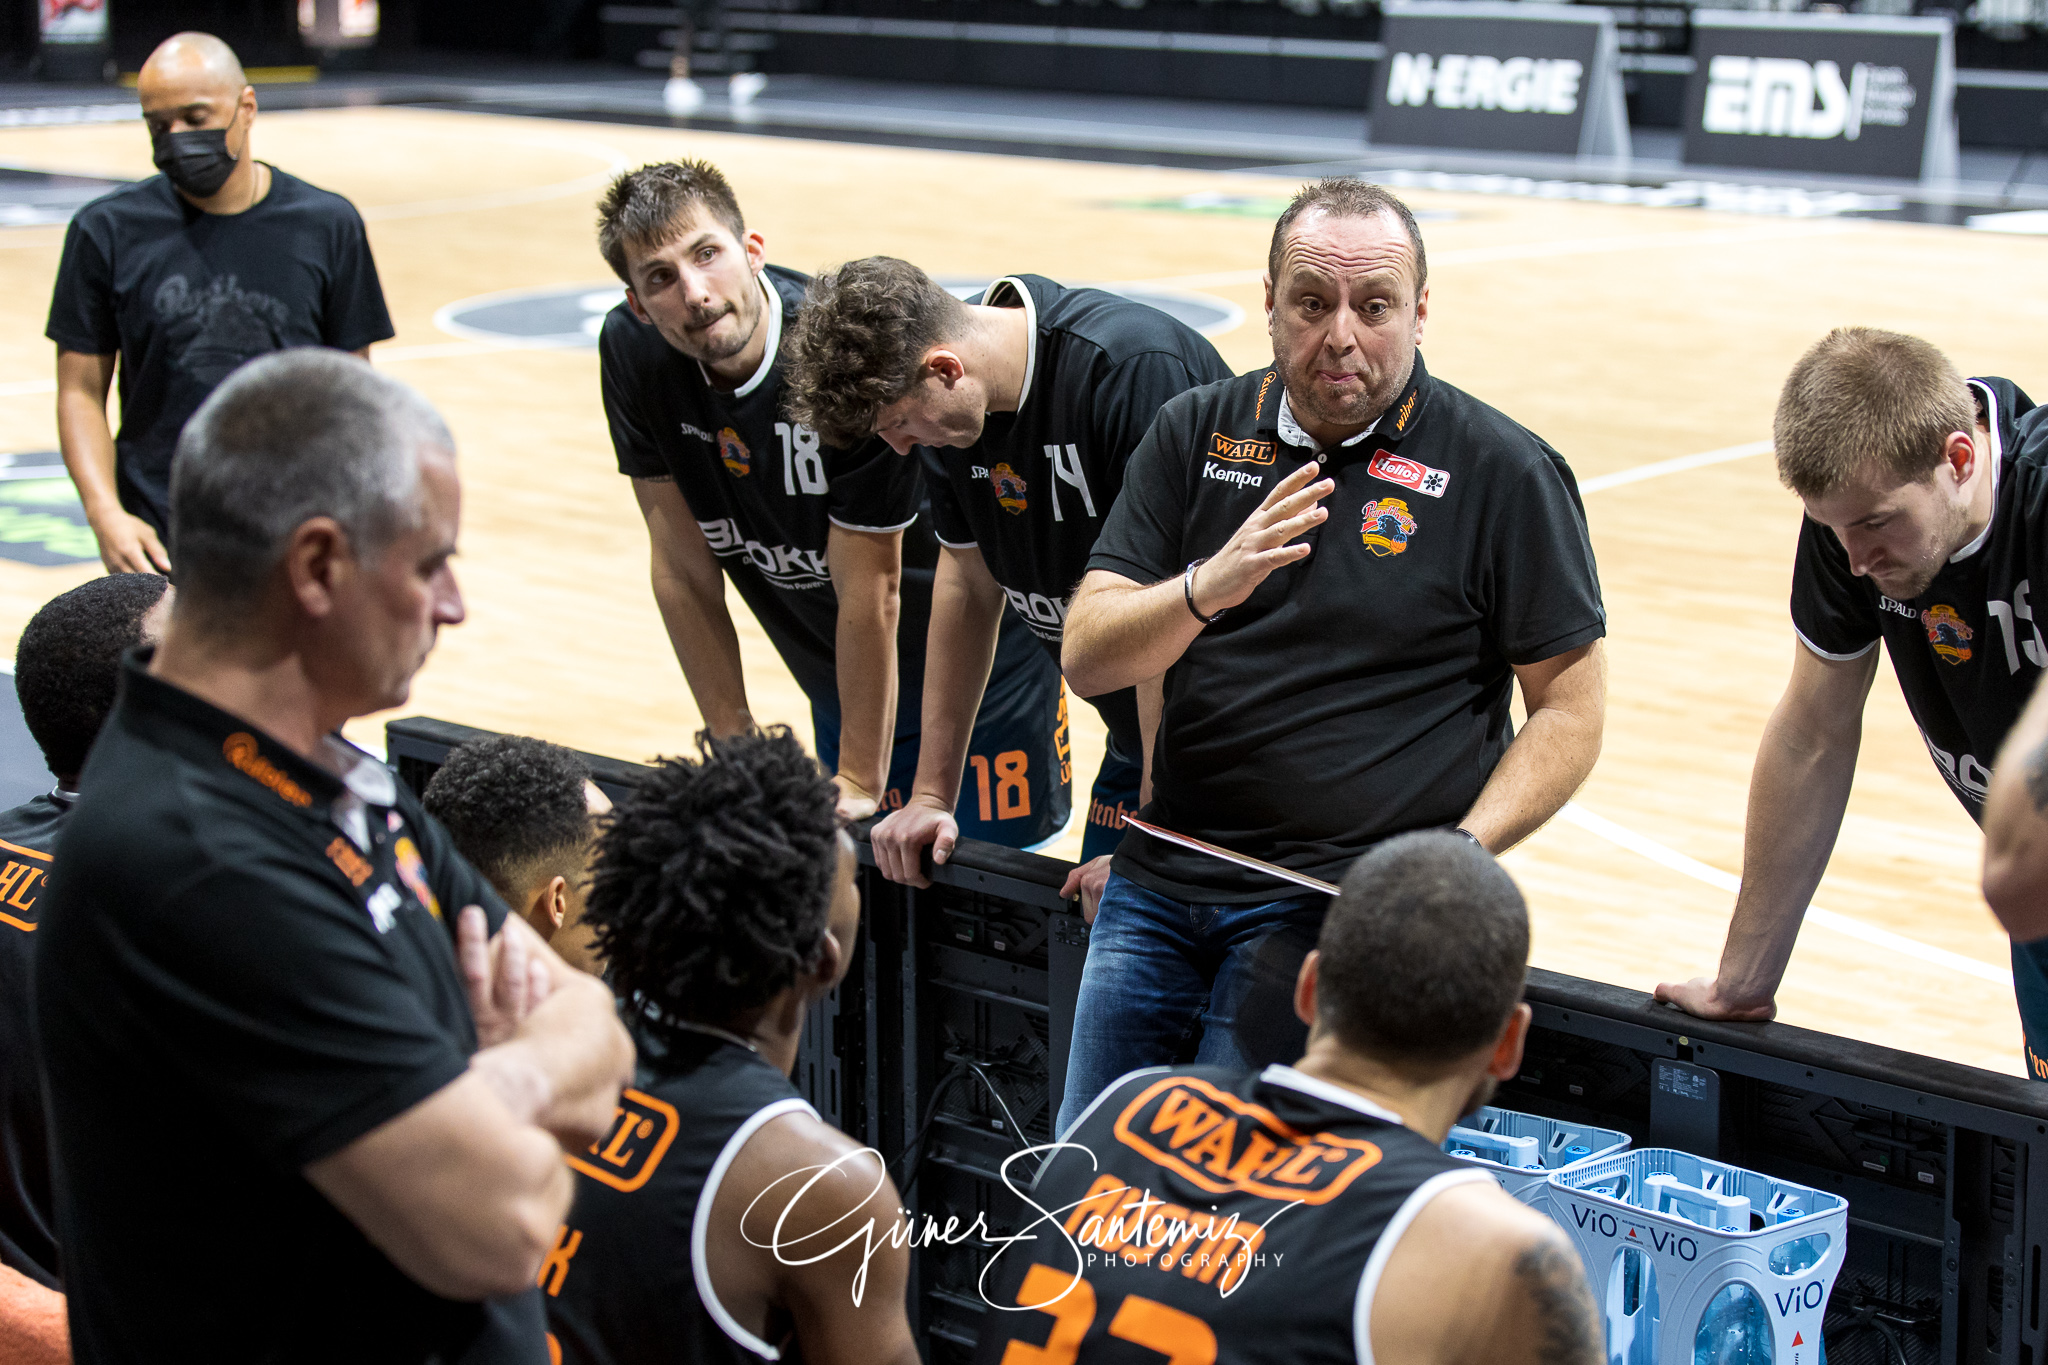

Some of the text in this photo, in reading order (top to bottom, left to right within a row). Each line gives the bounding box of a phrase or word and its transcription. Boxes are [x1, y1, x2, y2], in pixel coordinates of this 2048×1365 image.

[1703, 55, 1851, 139] EMS
[774, 422, 829, 496] 18
[1043, 443, 1097, 521] 14
[1202, 461, 1263, 489] Kempa
[1216, 438, 1270, 460] WAHL
[1375, 458, 1421, 482] Helios
[1987, 579, 2048, 676] 15
[970, 749, 1031, 821] 18
[1150, 1087, 1330, 1185] WAHL
[1571, 1203, 1698, 1262] ViO ViO
[1774, 1280, 1824, 1317] ViO
